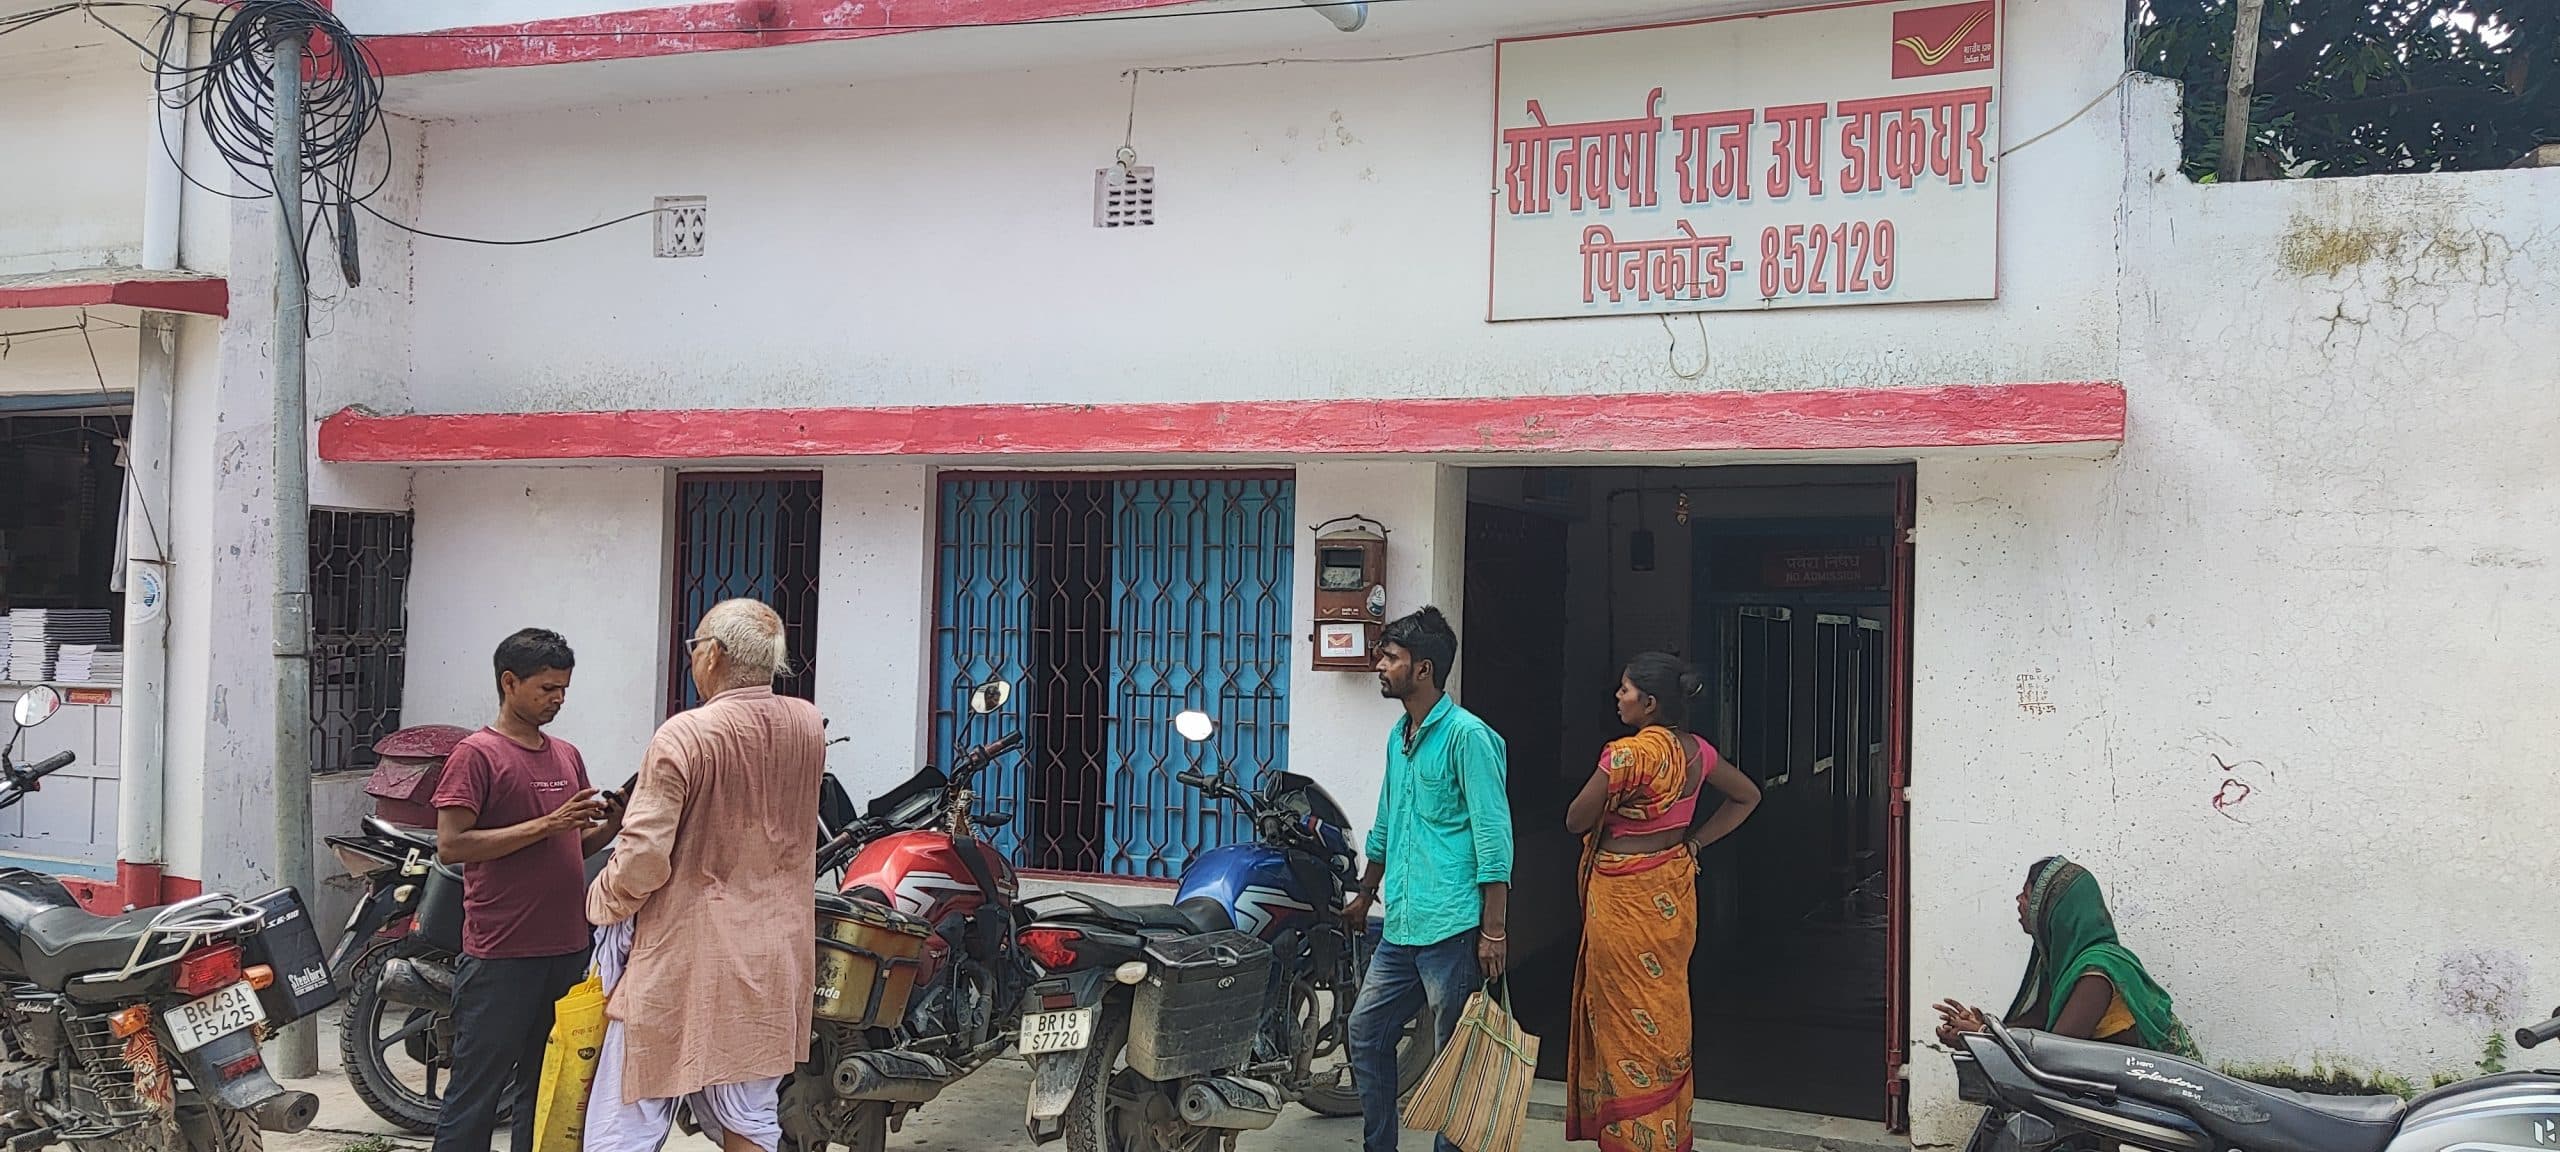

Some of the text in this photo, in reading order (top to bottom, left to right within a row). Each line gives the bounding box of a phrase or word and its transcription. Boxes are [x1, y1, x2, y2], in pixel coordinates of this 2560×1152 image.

[1503, 86, 1993, 215] सोनवर्षा राज उप डाकघर
[1579, 219, 1896, 303] पिनकोड- 852129
[1784, 570, 1862, 583] NO ADMISSION
[183, 988, 247, 1024] BR43A
[192, 1004, 255, 1043] F5425
[1038, 1012, 1077, 1032] BR19
[1032, 1029, 1080, 1050] S7720
